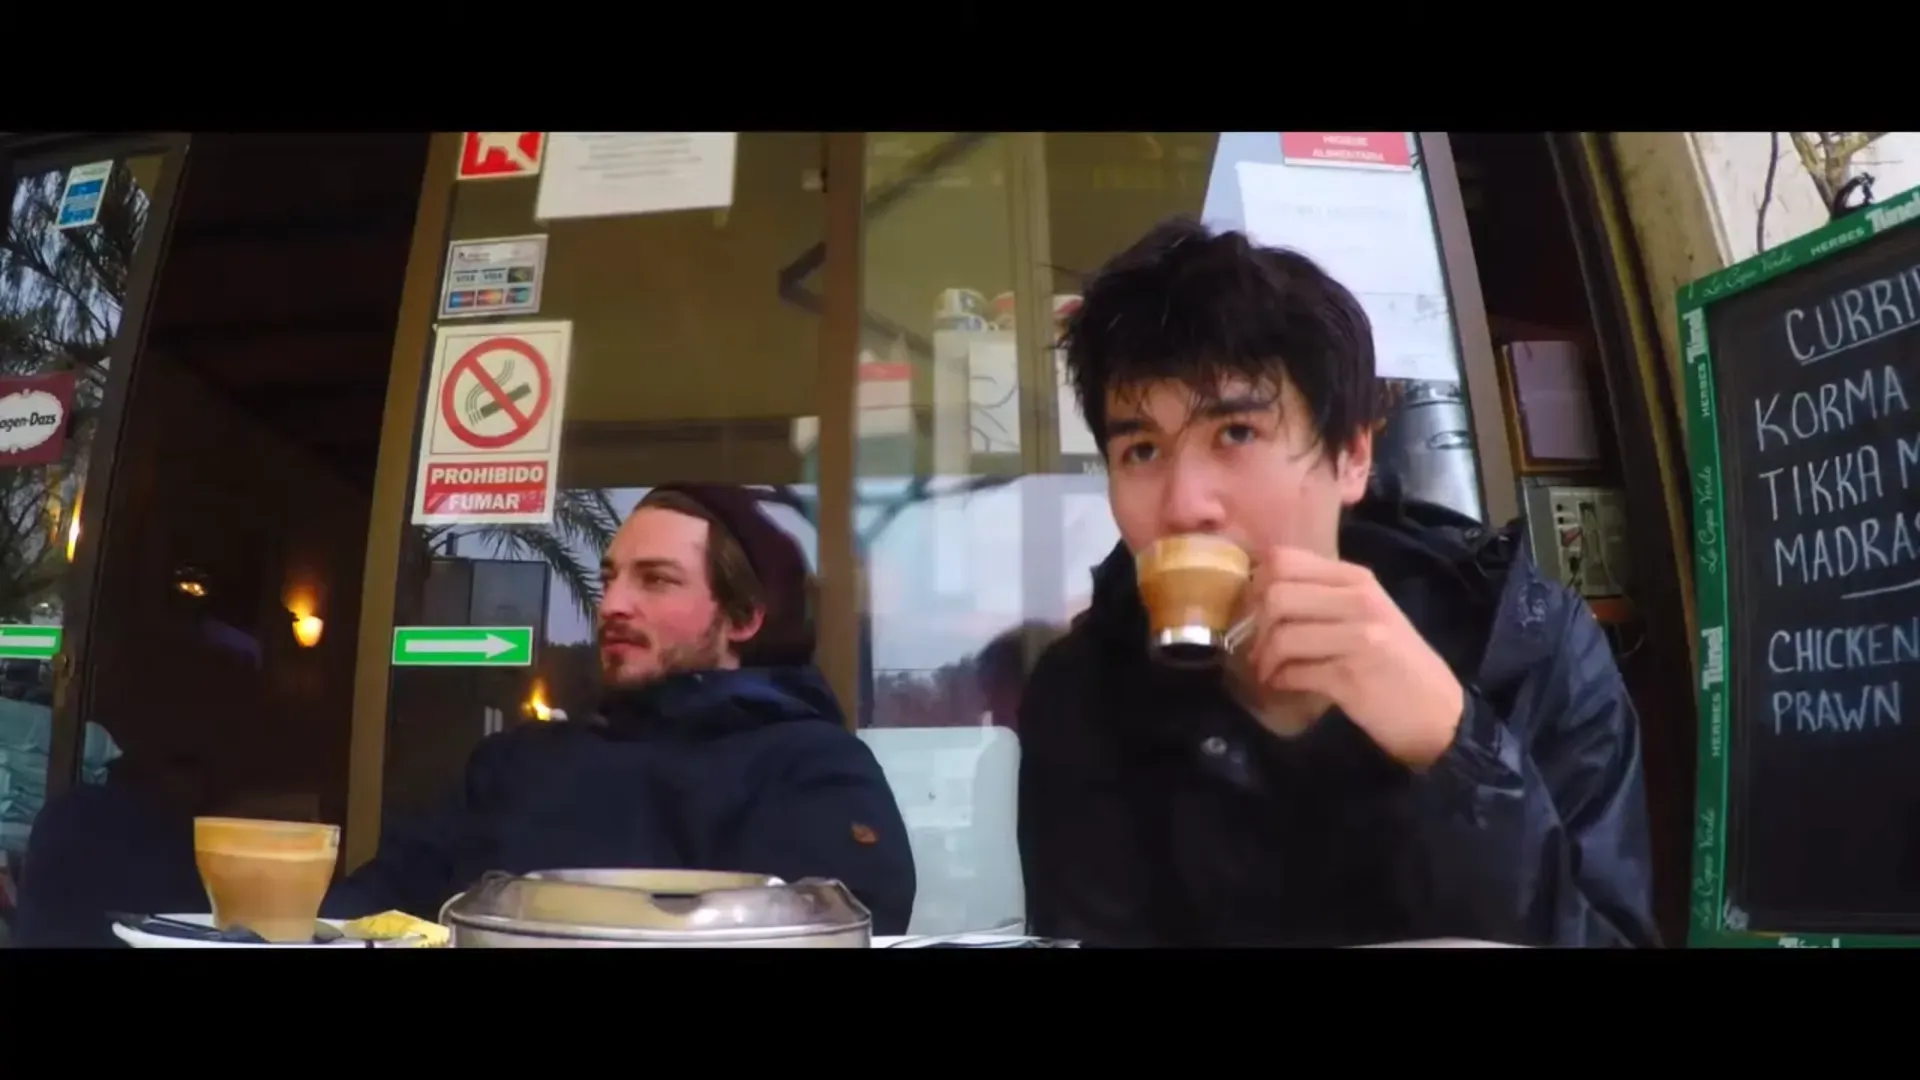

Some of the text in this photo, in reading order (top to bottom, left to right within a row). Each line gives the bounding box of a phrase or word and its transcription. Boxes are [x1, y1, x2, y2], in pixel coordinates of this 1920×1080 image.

[1312, 148, 1386, 162] ALIMENTARIA
[1810, 226, 1865, 256] HERBES
[1698, 363, 1710, 417] HERBES
[1755, 364, 1910, 451] KORMA
[431, 464, 544, 485] PROHIBIDO
[447, 492, 521, 511] FUMAR
[1758, 445, 1884, 521] TIKKA
[1768, 616, 1920, 673] CHICKEN
[1712, 692, 1722, 757] HERBES
[1772, 680, 1902, 735] PRAWN
